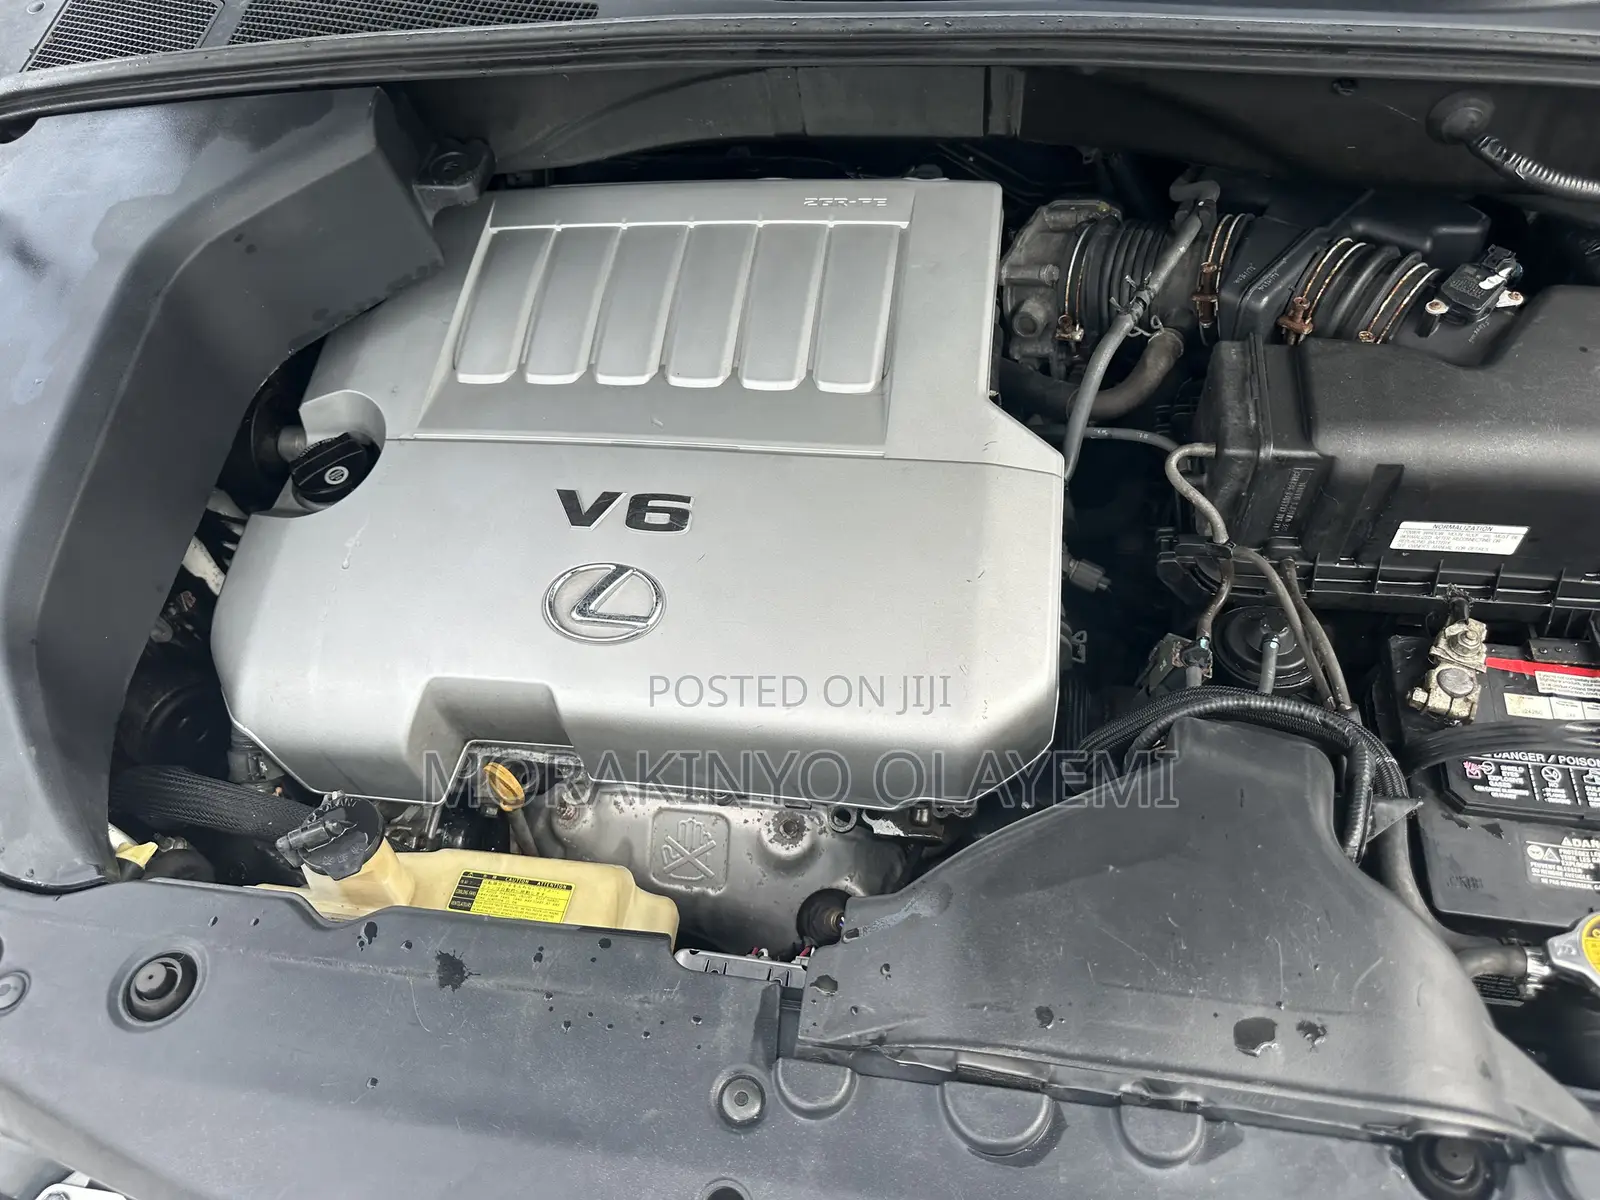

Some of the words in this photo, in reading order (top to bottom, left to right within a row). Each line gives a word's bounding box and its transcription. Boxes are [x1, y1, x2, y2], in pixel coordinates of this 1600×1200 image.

[555, 489, 695, 534] V6
[1433, 524, 1493, 532] NORMALIZATION
[1494, 751, 1545, 763] DANGER
